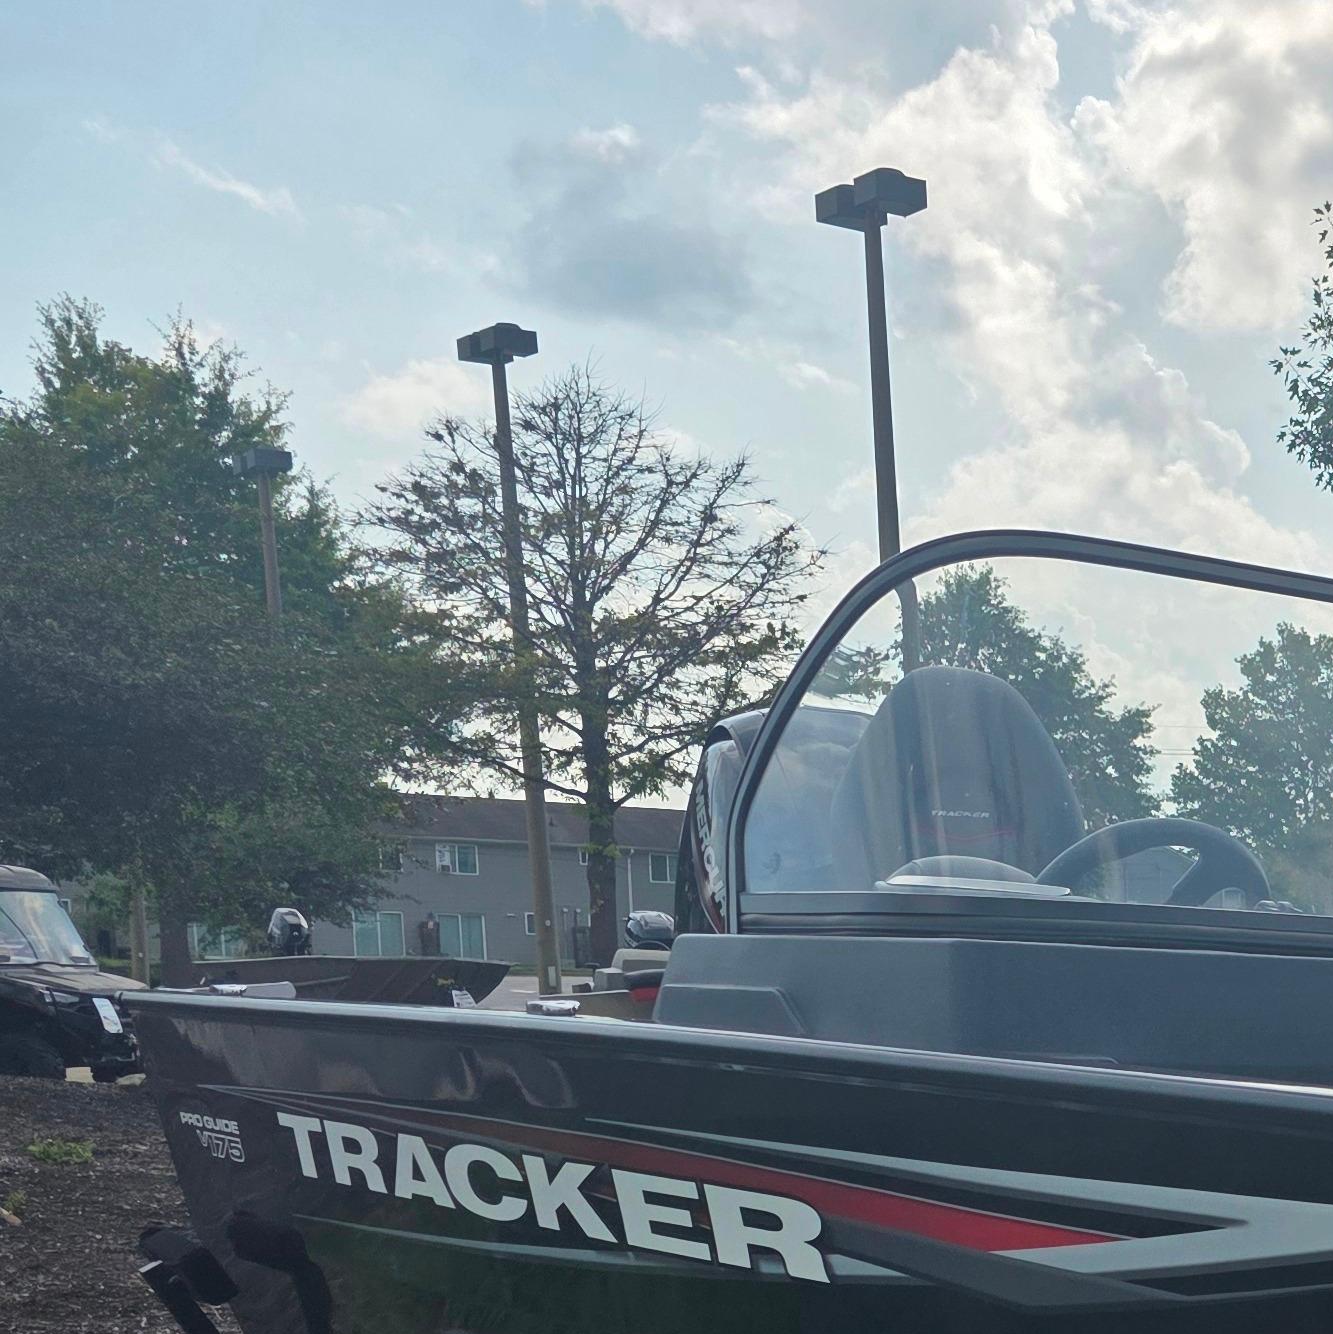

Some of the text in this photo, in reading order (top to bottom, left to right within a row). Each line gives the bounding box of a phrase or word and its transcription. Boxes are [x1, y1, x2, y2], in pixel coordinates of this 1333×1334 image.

[931, 809, 992, 819] TRACKER
[179, 1111, 240, 1135] PRO GUIDE
[276, 1110, 831, 1284] TRACKER
